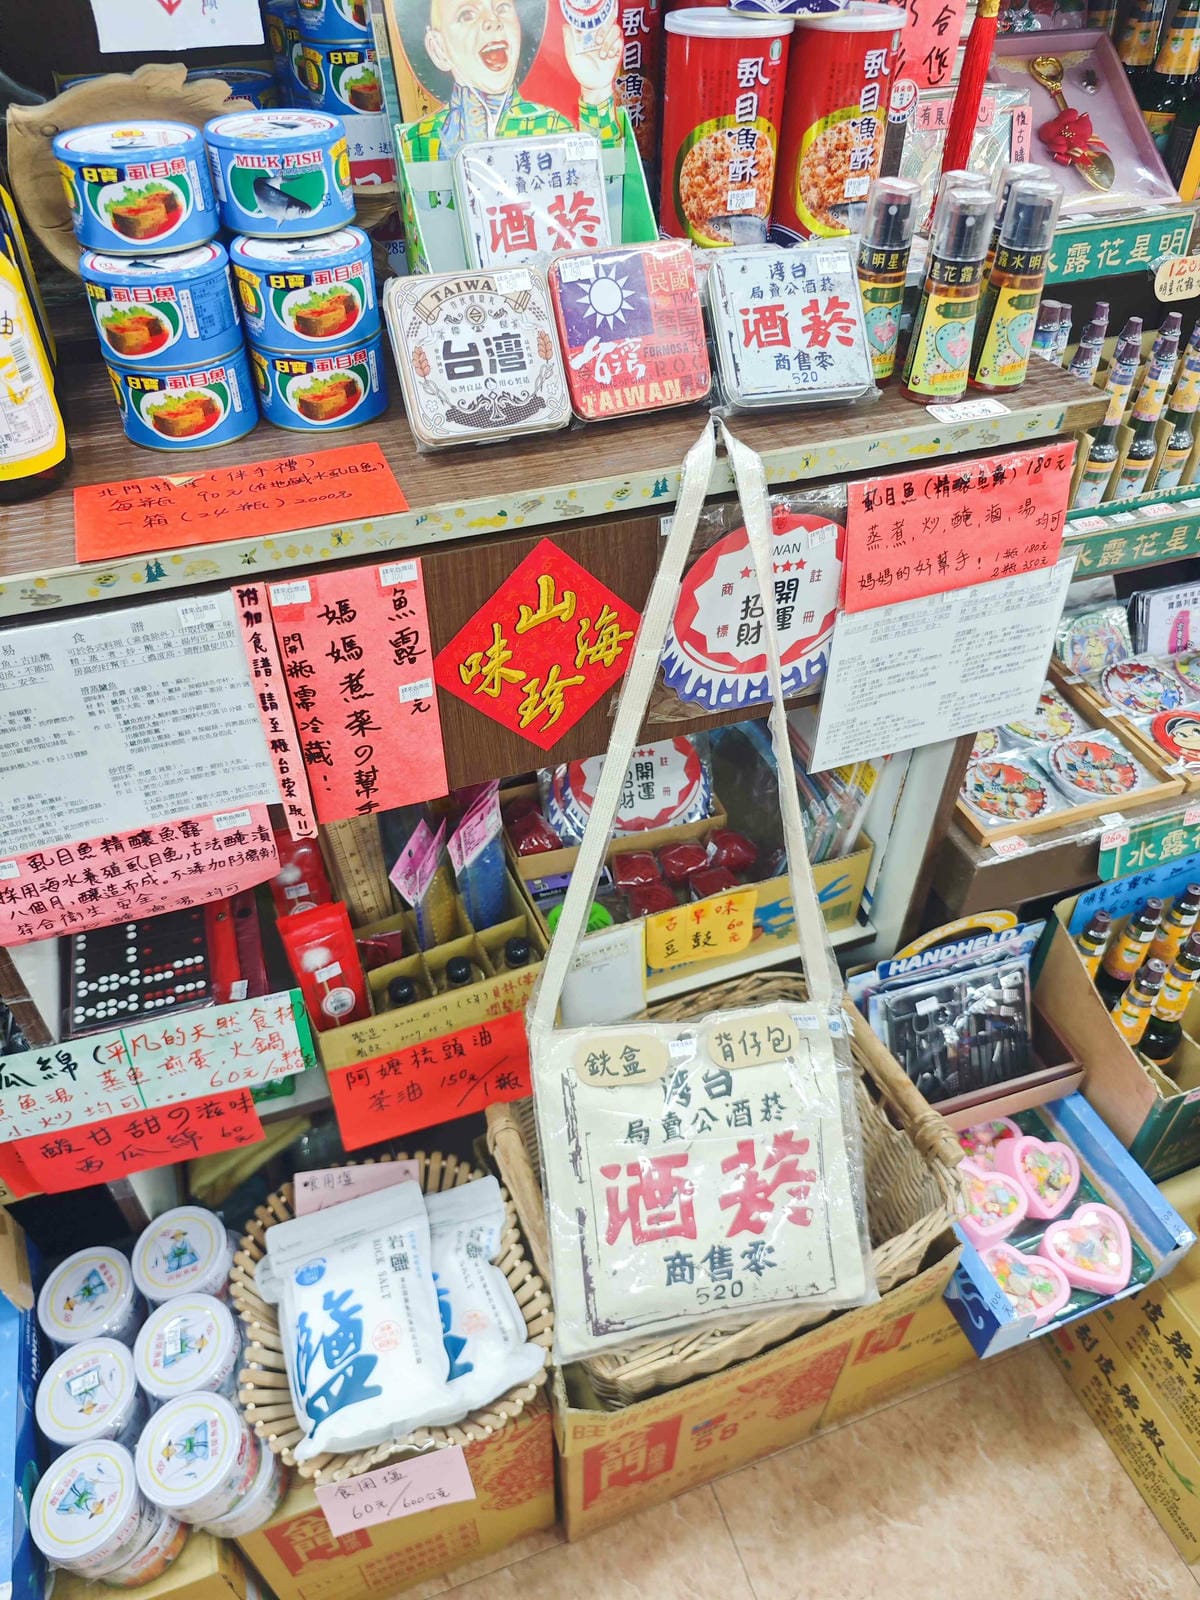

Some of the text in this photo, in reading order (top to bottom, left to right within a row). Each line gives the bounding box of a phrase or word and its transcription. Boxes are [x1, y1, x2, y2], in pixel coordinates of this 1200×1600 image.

[727, 56, 770, 183] 虱目魚酥
[126, 158, 189, 182] 虱目魚
[235, 154, 281, 170] MILK
[283, 149, 323, 168] FISH
[110, 286, 176, 303] 虱目魚
[430, 278, 499, 303] TAIWA
[315, 348, 368, 372] 虱目魚
[167, 367, 227, 390] 虱目魚
[791, 370, 819, 385] 520
[581, 378, 682, 416] TAIWAN
[888, 928, 1018, 976] HANDHELD
[695, 1278, 745, 1306] 520
